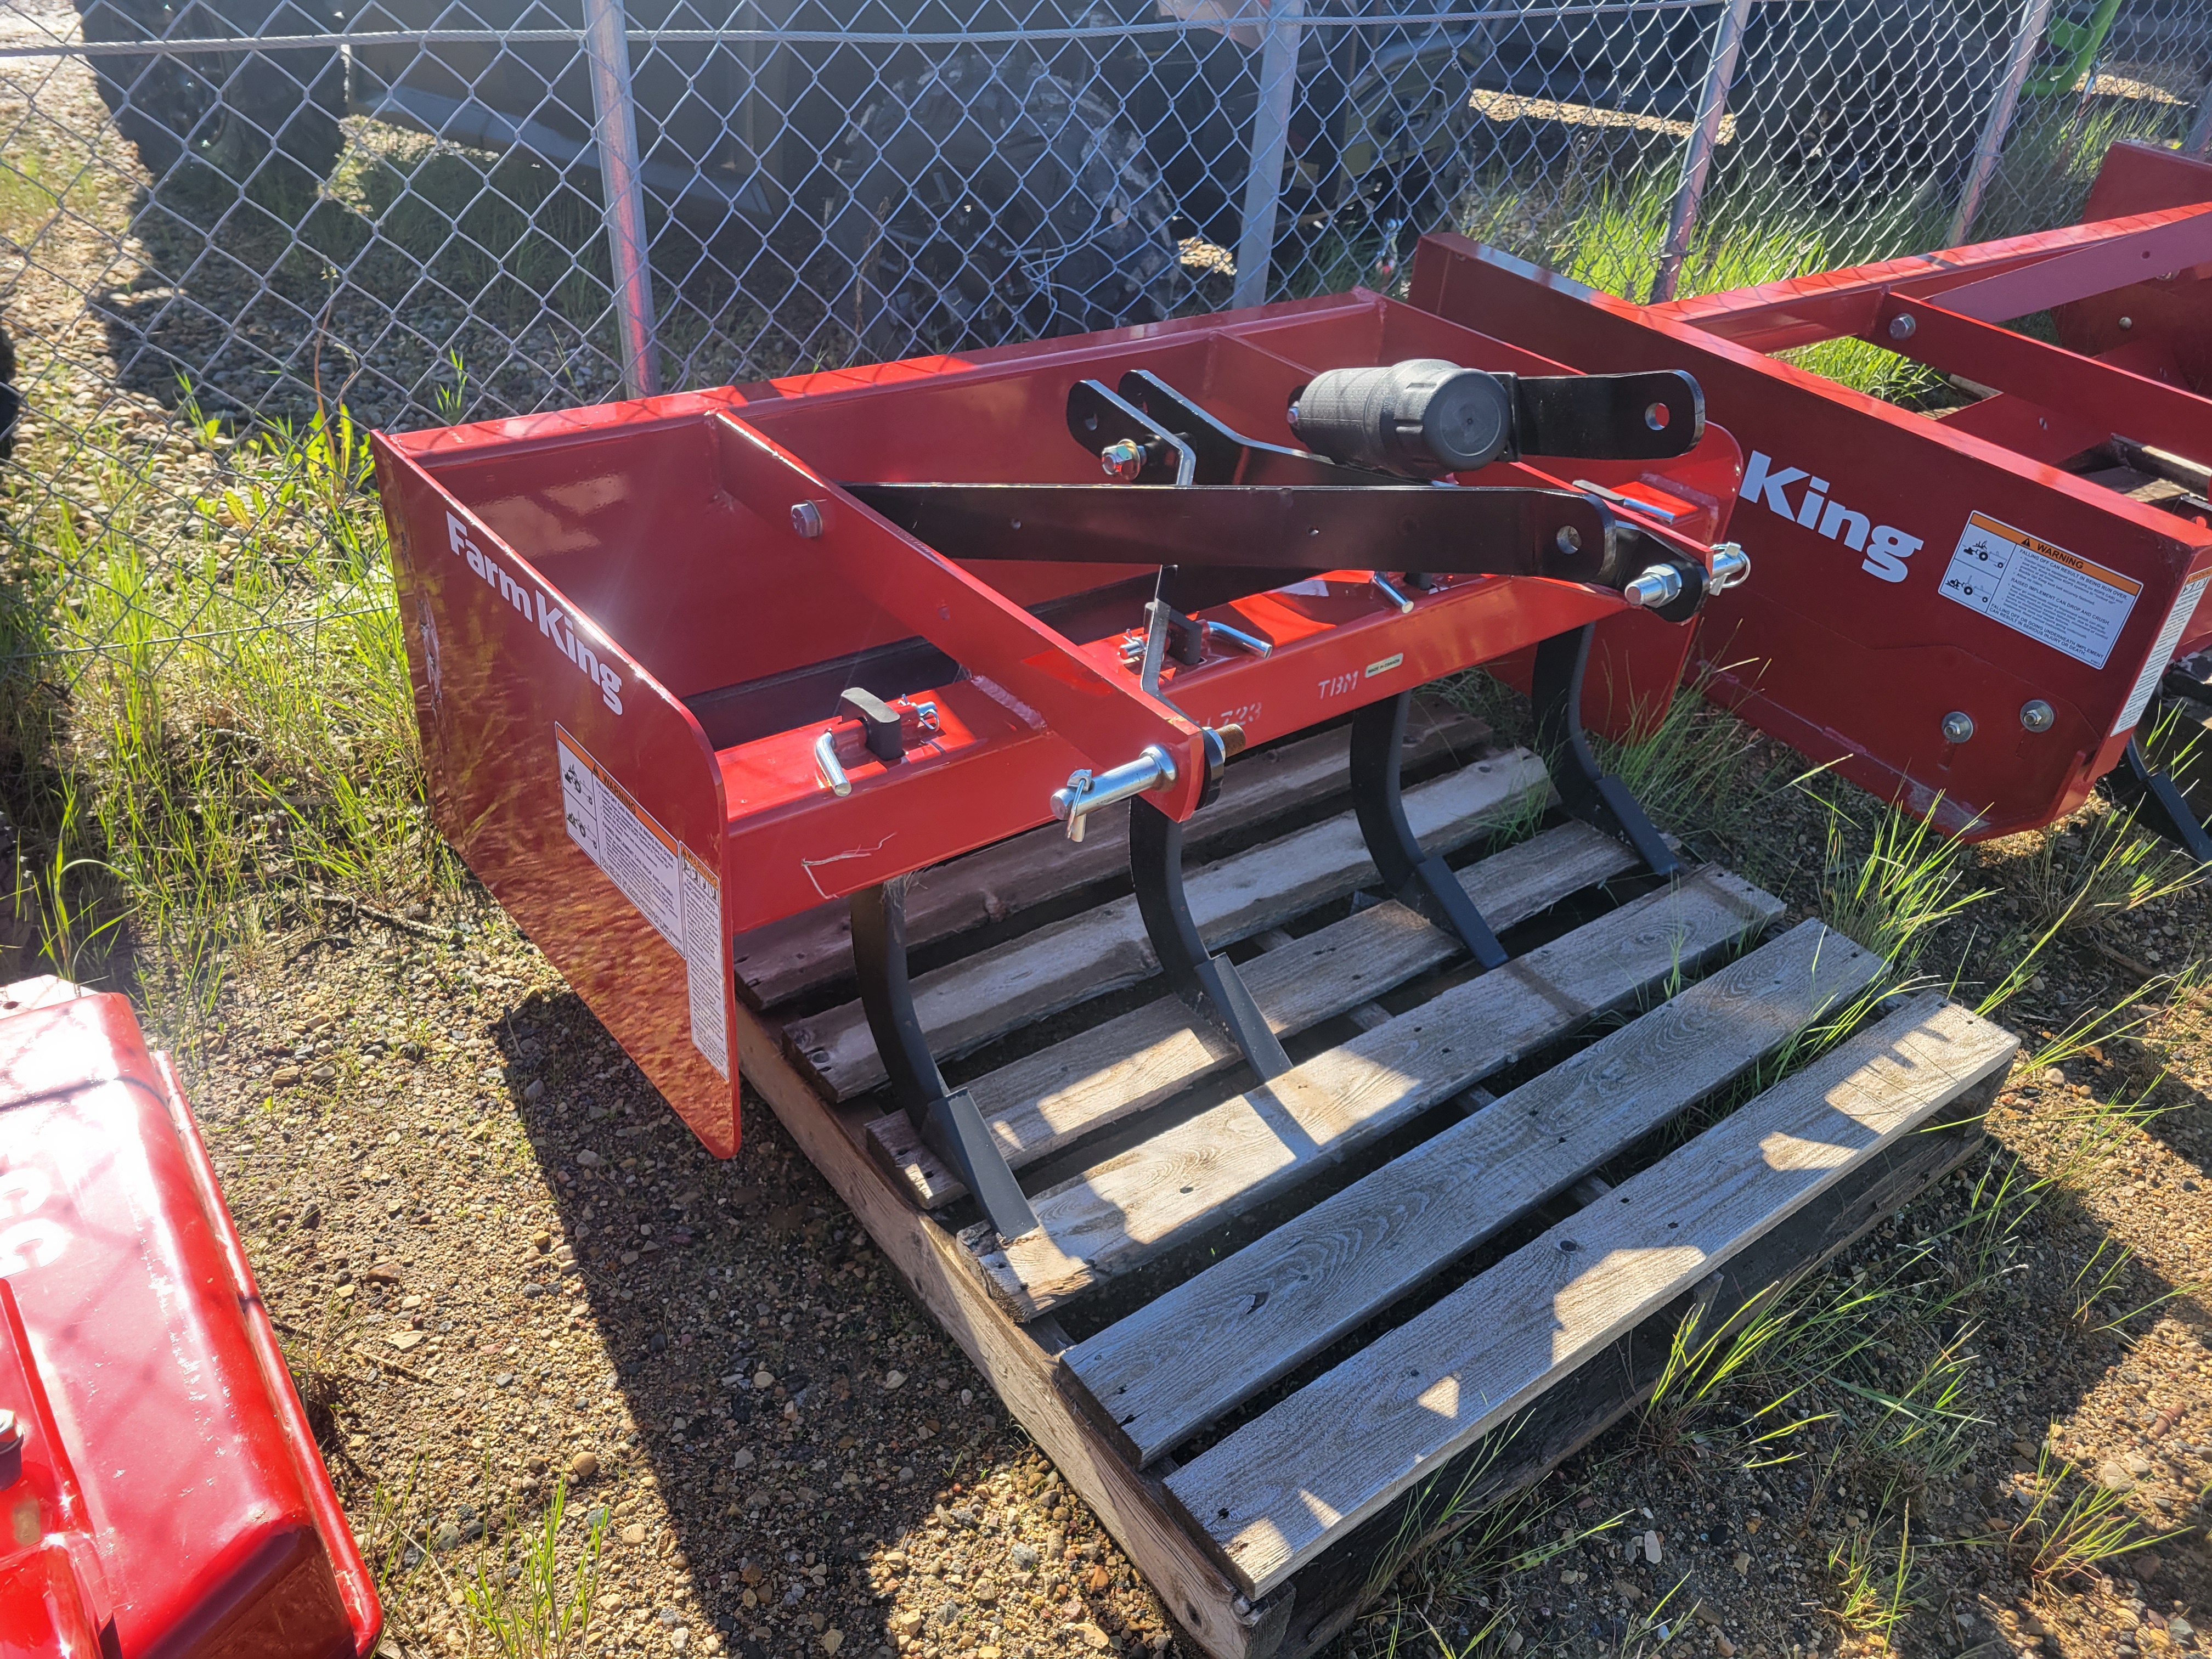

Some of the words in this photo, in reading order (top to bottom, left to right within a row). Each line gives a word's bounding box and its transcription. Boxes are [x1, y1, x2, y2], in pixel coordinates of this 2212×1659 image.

[1739, 450, 1924, 583] King
[2019, 549, 2039, 561] FALLING
[2049, 562, 2061, 570] CAN
[2059, 567, 2079, 578] RESULT
[2085, 578, 2101, 588] BEING
[2101, 585, 2113, 593] RUN
[2112, 590, 2128, 600] OVER.
[2035, 543, 2085, 569] WARNING
[446, 510, 533, 622] Farm
[535, 589, 623, 715] King
[2010, 577, 2028, 588] RAISED
[2028, 585, 2055, 600] IMPLEMENT
[2055, 597, 2067, 606] CAN
[2066, 602, 2081, 612] DROP
[2080, 609, 2092, 617] AND
[2091, 614, 2111, 625] CRUSH.
[1990, 603, 2010, 615] FALLING
[2027, 620, 2044, 631] GOING
[2043, 628, 2075, 646] UNDERNEATH
[2075, 643, 2103, 659] IMPLEMENT
[1999, 612, 2017, 623] RESULT
[2022, 623, 2044, 636] SERIOUS
[2043, 633, 2061, 644] INJURY
[2068, 645, 2086, 656] DEATH.
[602, 772, 636, 816] WARNING
